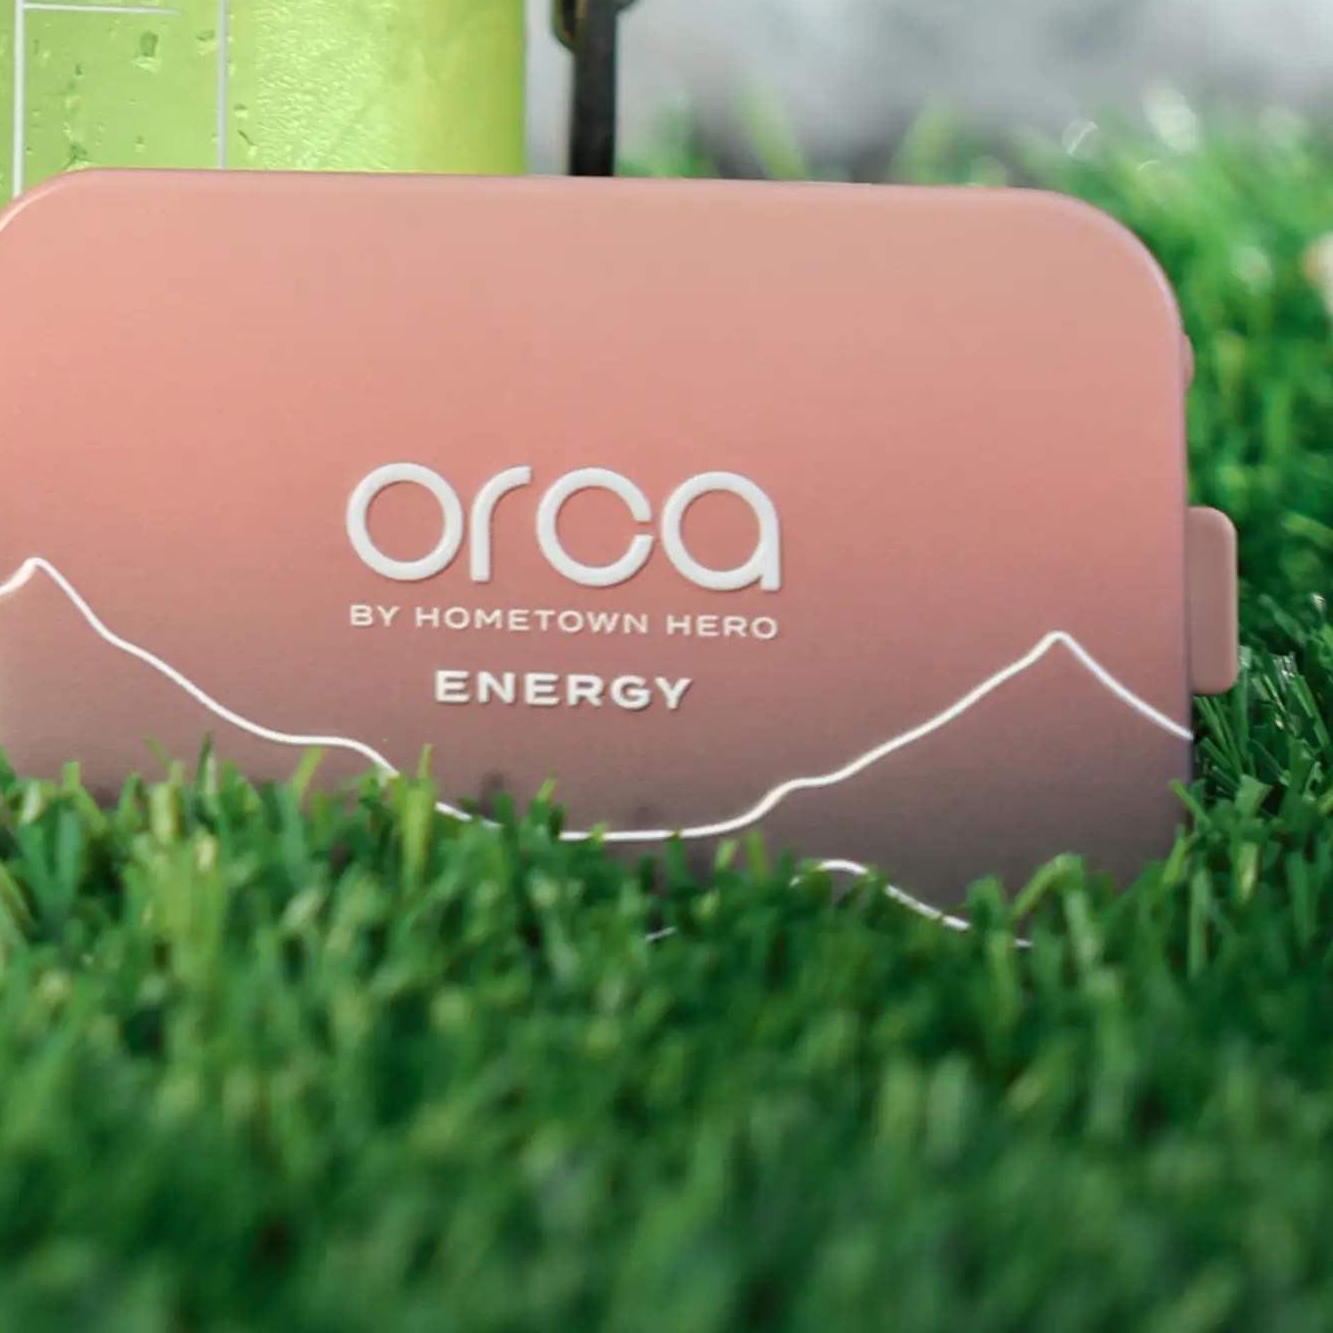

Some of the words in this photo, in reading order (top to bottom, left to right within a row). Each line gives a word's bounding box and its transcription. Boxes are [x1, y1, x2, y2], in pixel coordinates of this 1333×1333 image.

[345, 461, 782, 592] orca
[349, 604, 400, 628] BY
[414, 606, 649, 634] HOMETOWN
[666, 614, 779, 641] HERO
[434, 669, 693, 710] ENERGY
